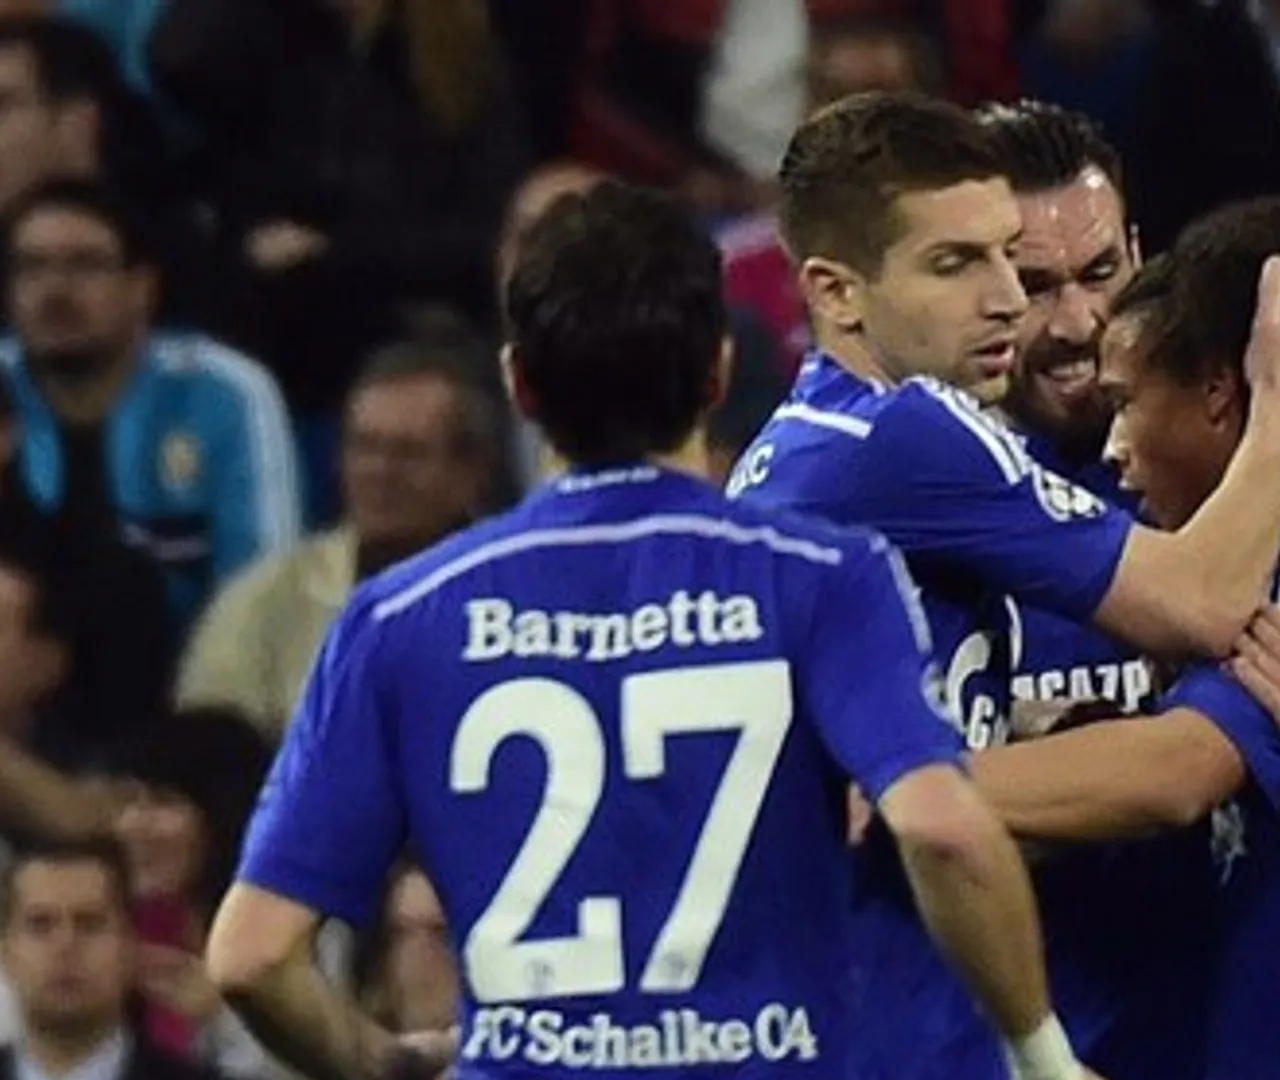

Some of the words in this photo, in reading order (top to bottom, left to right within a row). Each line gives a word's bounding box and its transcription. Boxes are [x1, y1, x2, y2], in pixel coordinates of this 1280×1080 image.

[463, 589, 763, 662] Barnetta
[450, 657, 793, 1004] 27
[524, 1009, 752, 1069] Schalke
[755, 1003, 818, 1061] 04
